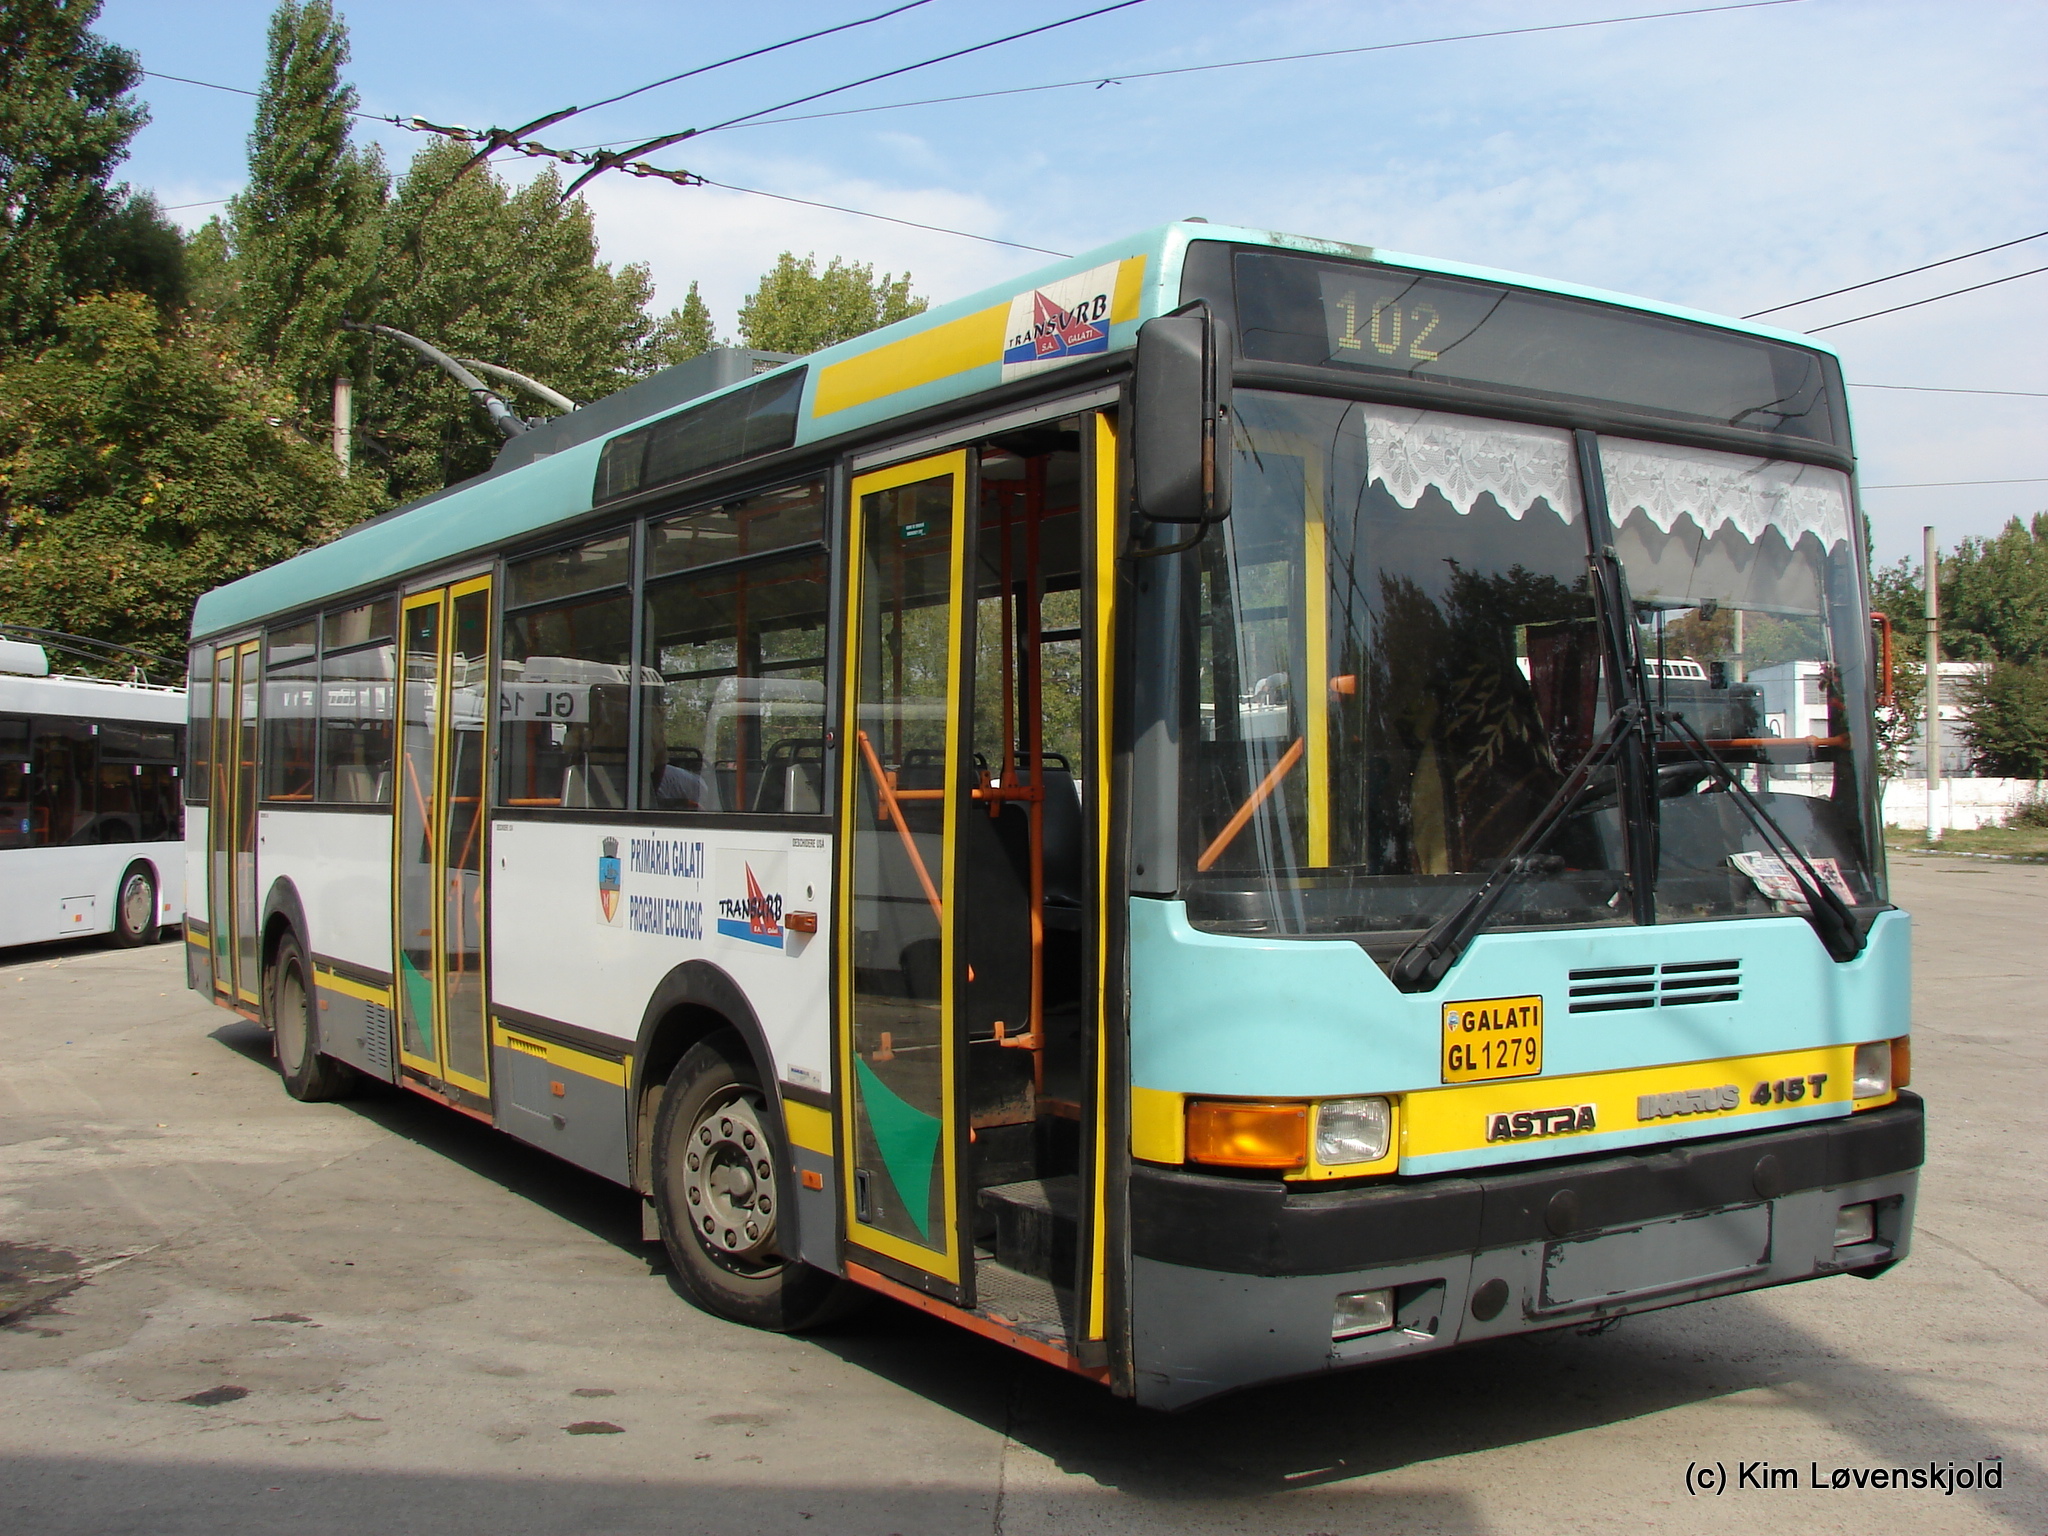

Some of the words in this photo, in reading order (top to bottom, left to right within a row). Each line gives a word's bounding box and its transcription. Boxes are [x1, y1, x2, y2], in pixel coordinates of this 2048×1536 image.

[1336, 290, 1439, 361] 102
[629, 894, 664, 934] PROGRAM
[665, 898, 703, 941] ECOLOGIC
[719, 892, 782, 921] TRANSURB
[1462, 1005, 1538, 1032] GALATI
[1637, 1085, 1740, 1121] IKARUS
[1488, 1105, 1596, 1141] ASTRA
